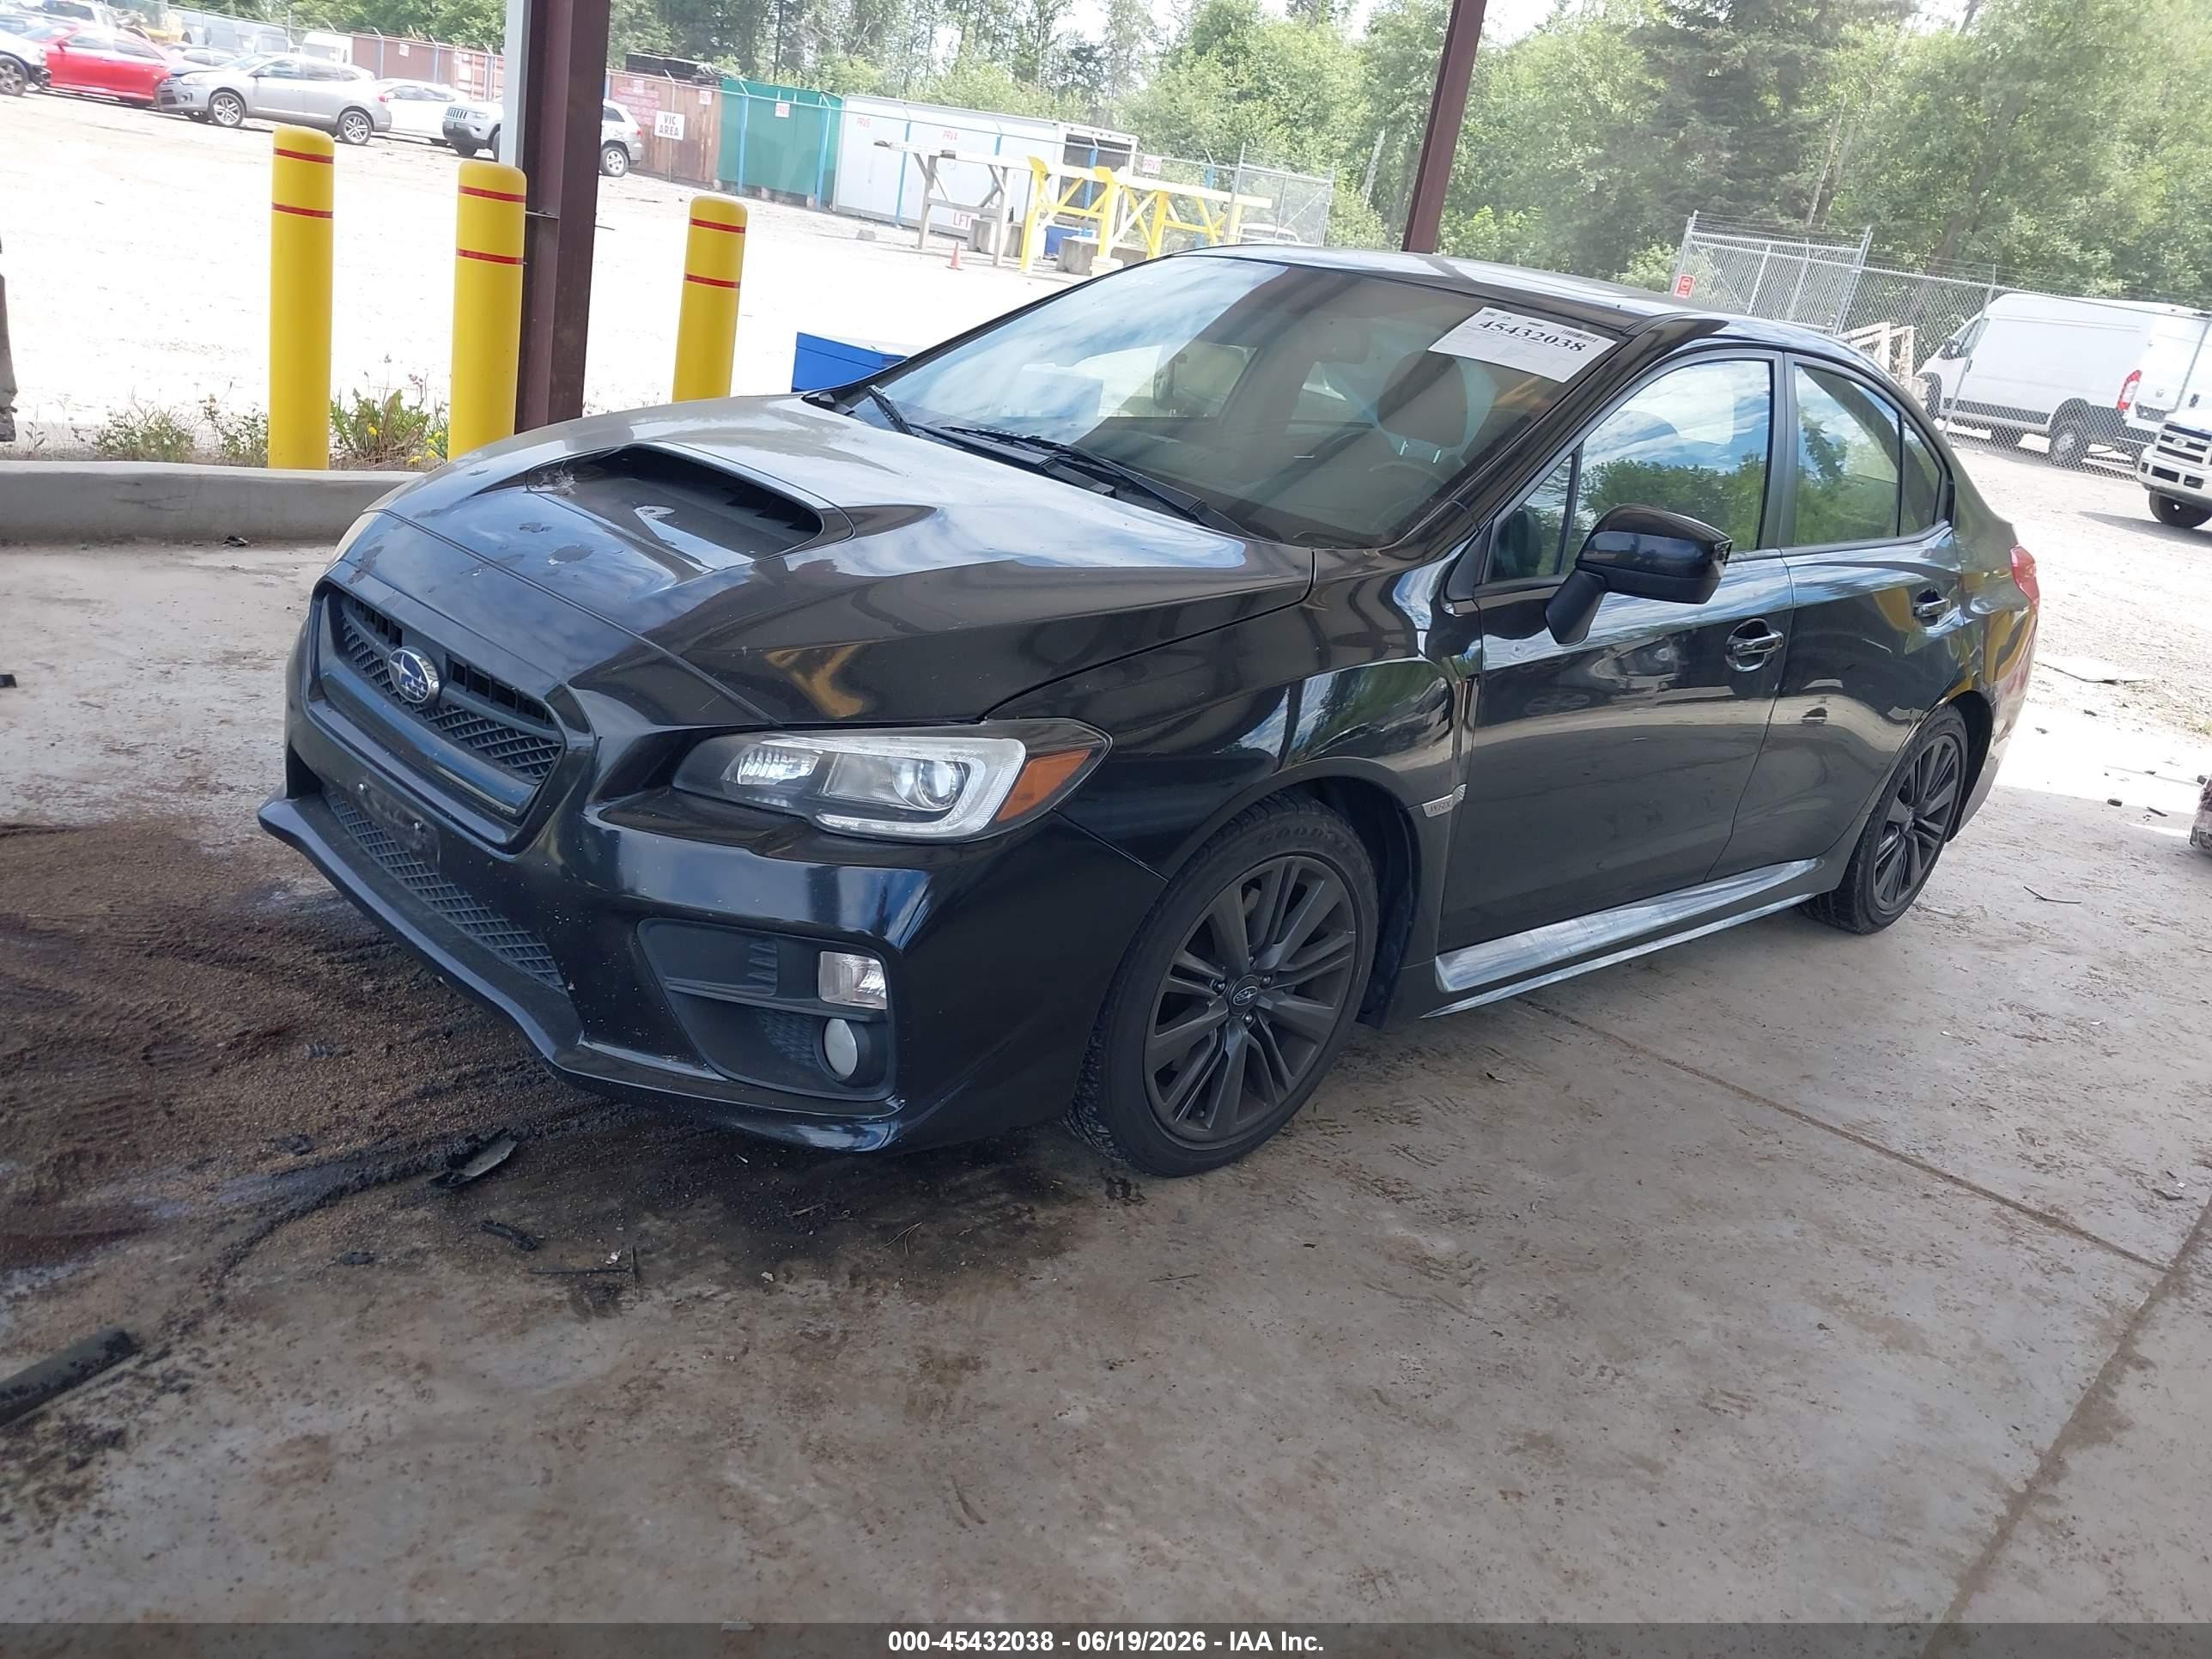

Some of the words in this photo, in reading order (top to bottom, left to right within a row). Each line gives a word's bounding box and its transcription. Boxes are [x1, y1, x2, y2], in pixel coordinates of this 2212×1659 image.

[664, 113, 678, 125] VIC
[659, 125, 680, 137] AREA
[1478, 320, 1587, 352] 45432038
